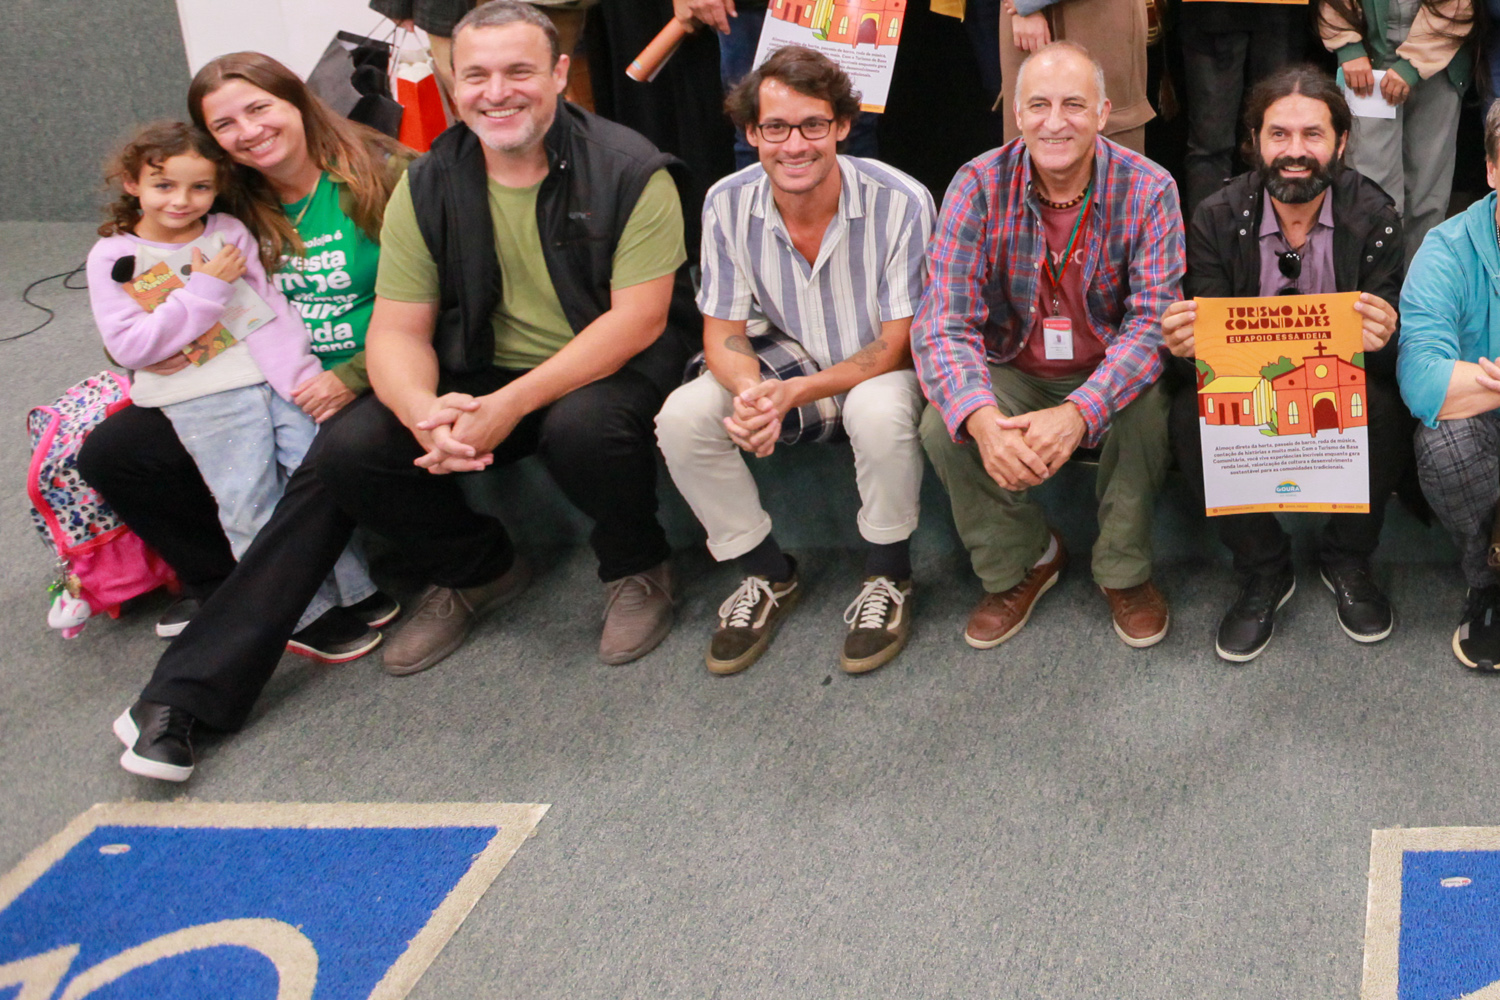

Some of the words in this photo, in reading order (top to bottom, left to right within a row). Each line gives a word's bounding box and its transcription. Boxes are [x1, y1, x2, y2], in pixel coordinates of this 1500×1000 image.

[1227, 305, 1293, 318] TURISMO
[1297, 303, 1327, 315] NAS
[1225, 316, 1330, 330] COMUNIDADES
[1244, 334, 1273, 342] APOIO
